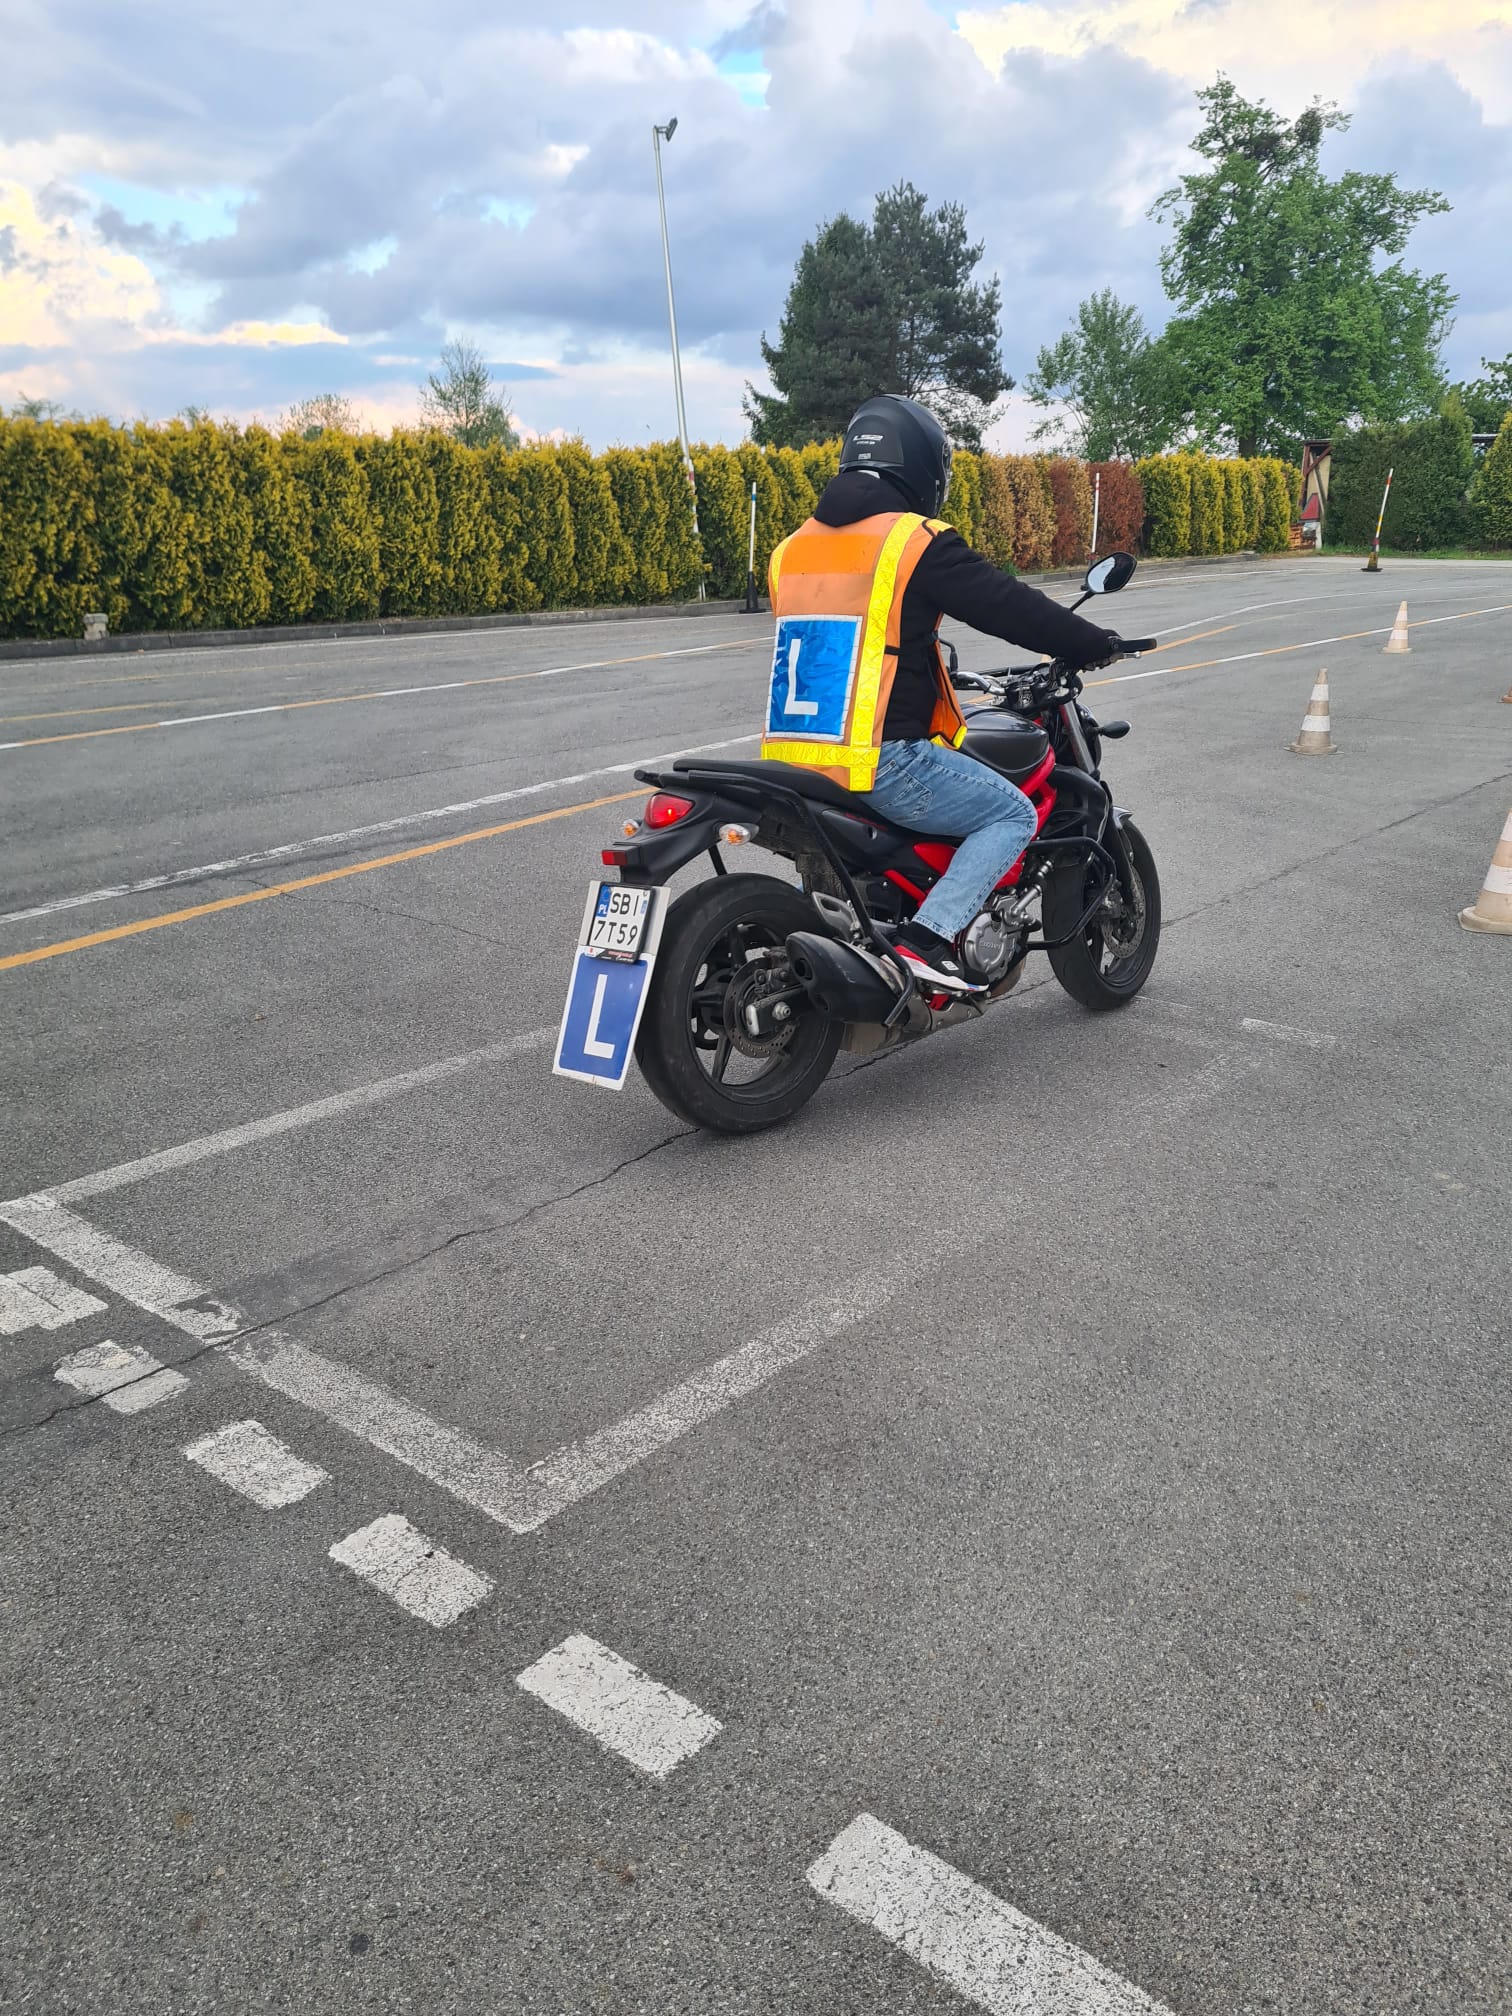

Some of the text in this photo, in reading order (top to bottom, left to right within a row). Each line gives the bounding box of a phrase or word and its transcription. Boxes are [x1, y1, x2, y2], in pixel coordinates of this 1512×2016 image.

[784, 638, 819, 716] L
[598, 903, 607, 914] PL
[610, 892, 639, 917] SBI
[594, 919, 638, 946] 7T59
[583, 973, 616, 1059] L
